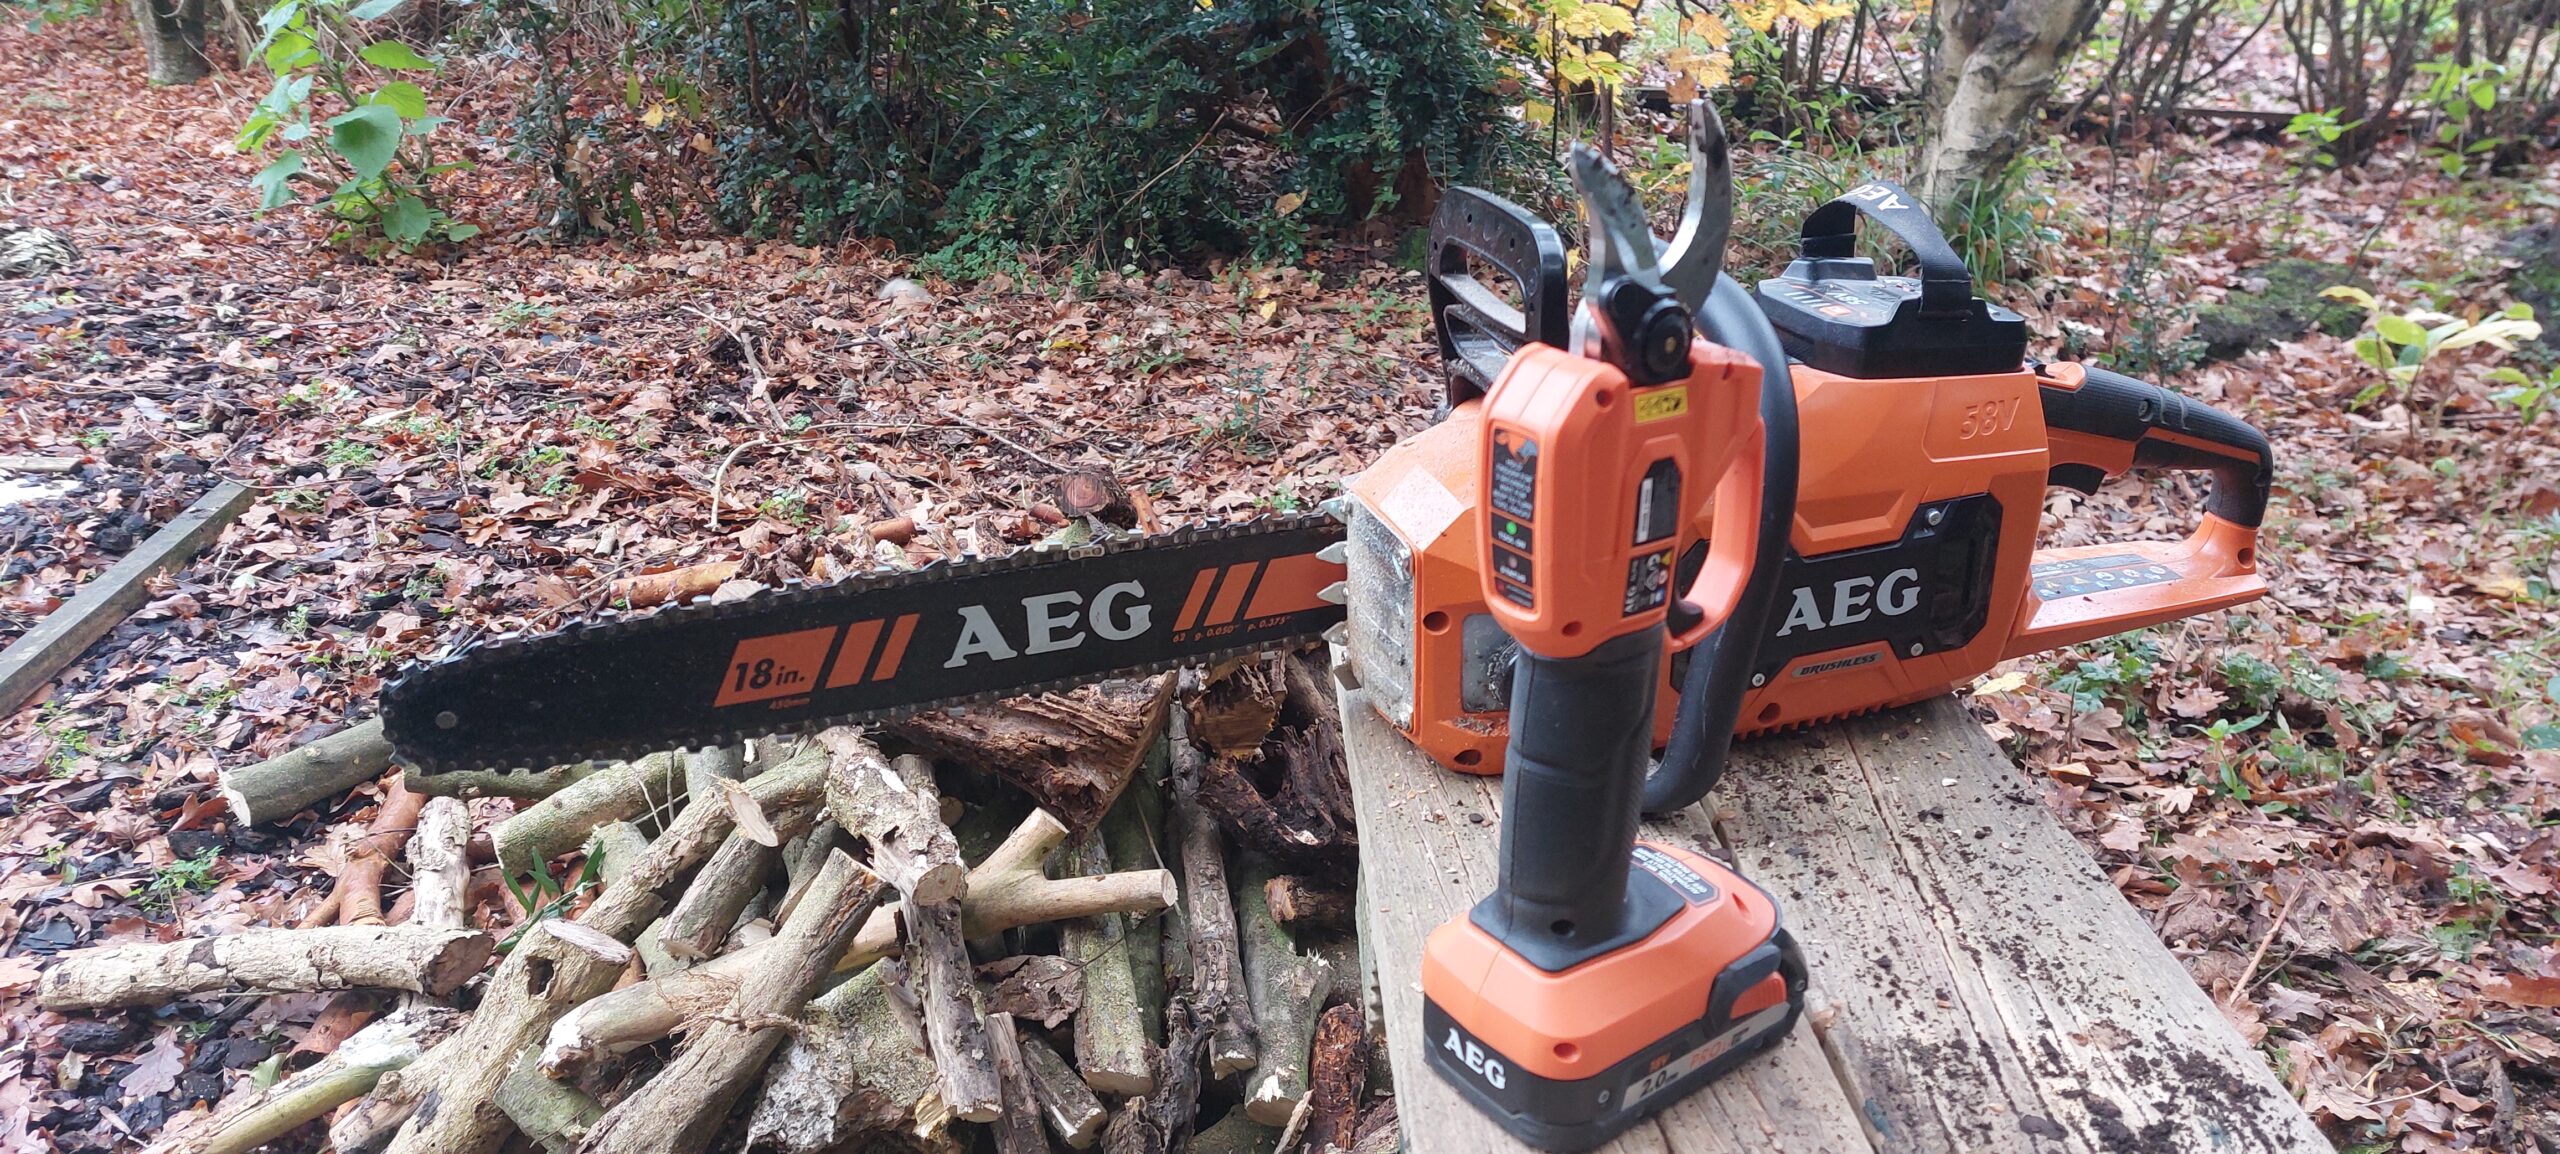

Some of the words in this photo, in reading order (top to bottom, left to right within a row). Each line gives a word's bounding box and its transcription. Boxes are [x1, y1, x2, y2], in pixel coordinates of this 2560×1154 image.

[1959, 395, 2021, 440] 58V
[943, 579, 1152, 669] AEG
[1775, 567, 1921, 637] AEG
[1799, 653, 1877, 676] BRUSHLESS
[1443, 1027, 1507, 1090] AEG
